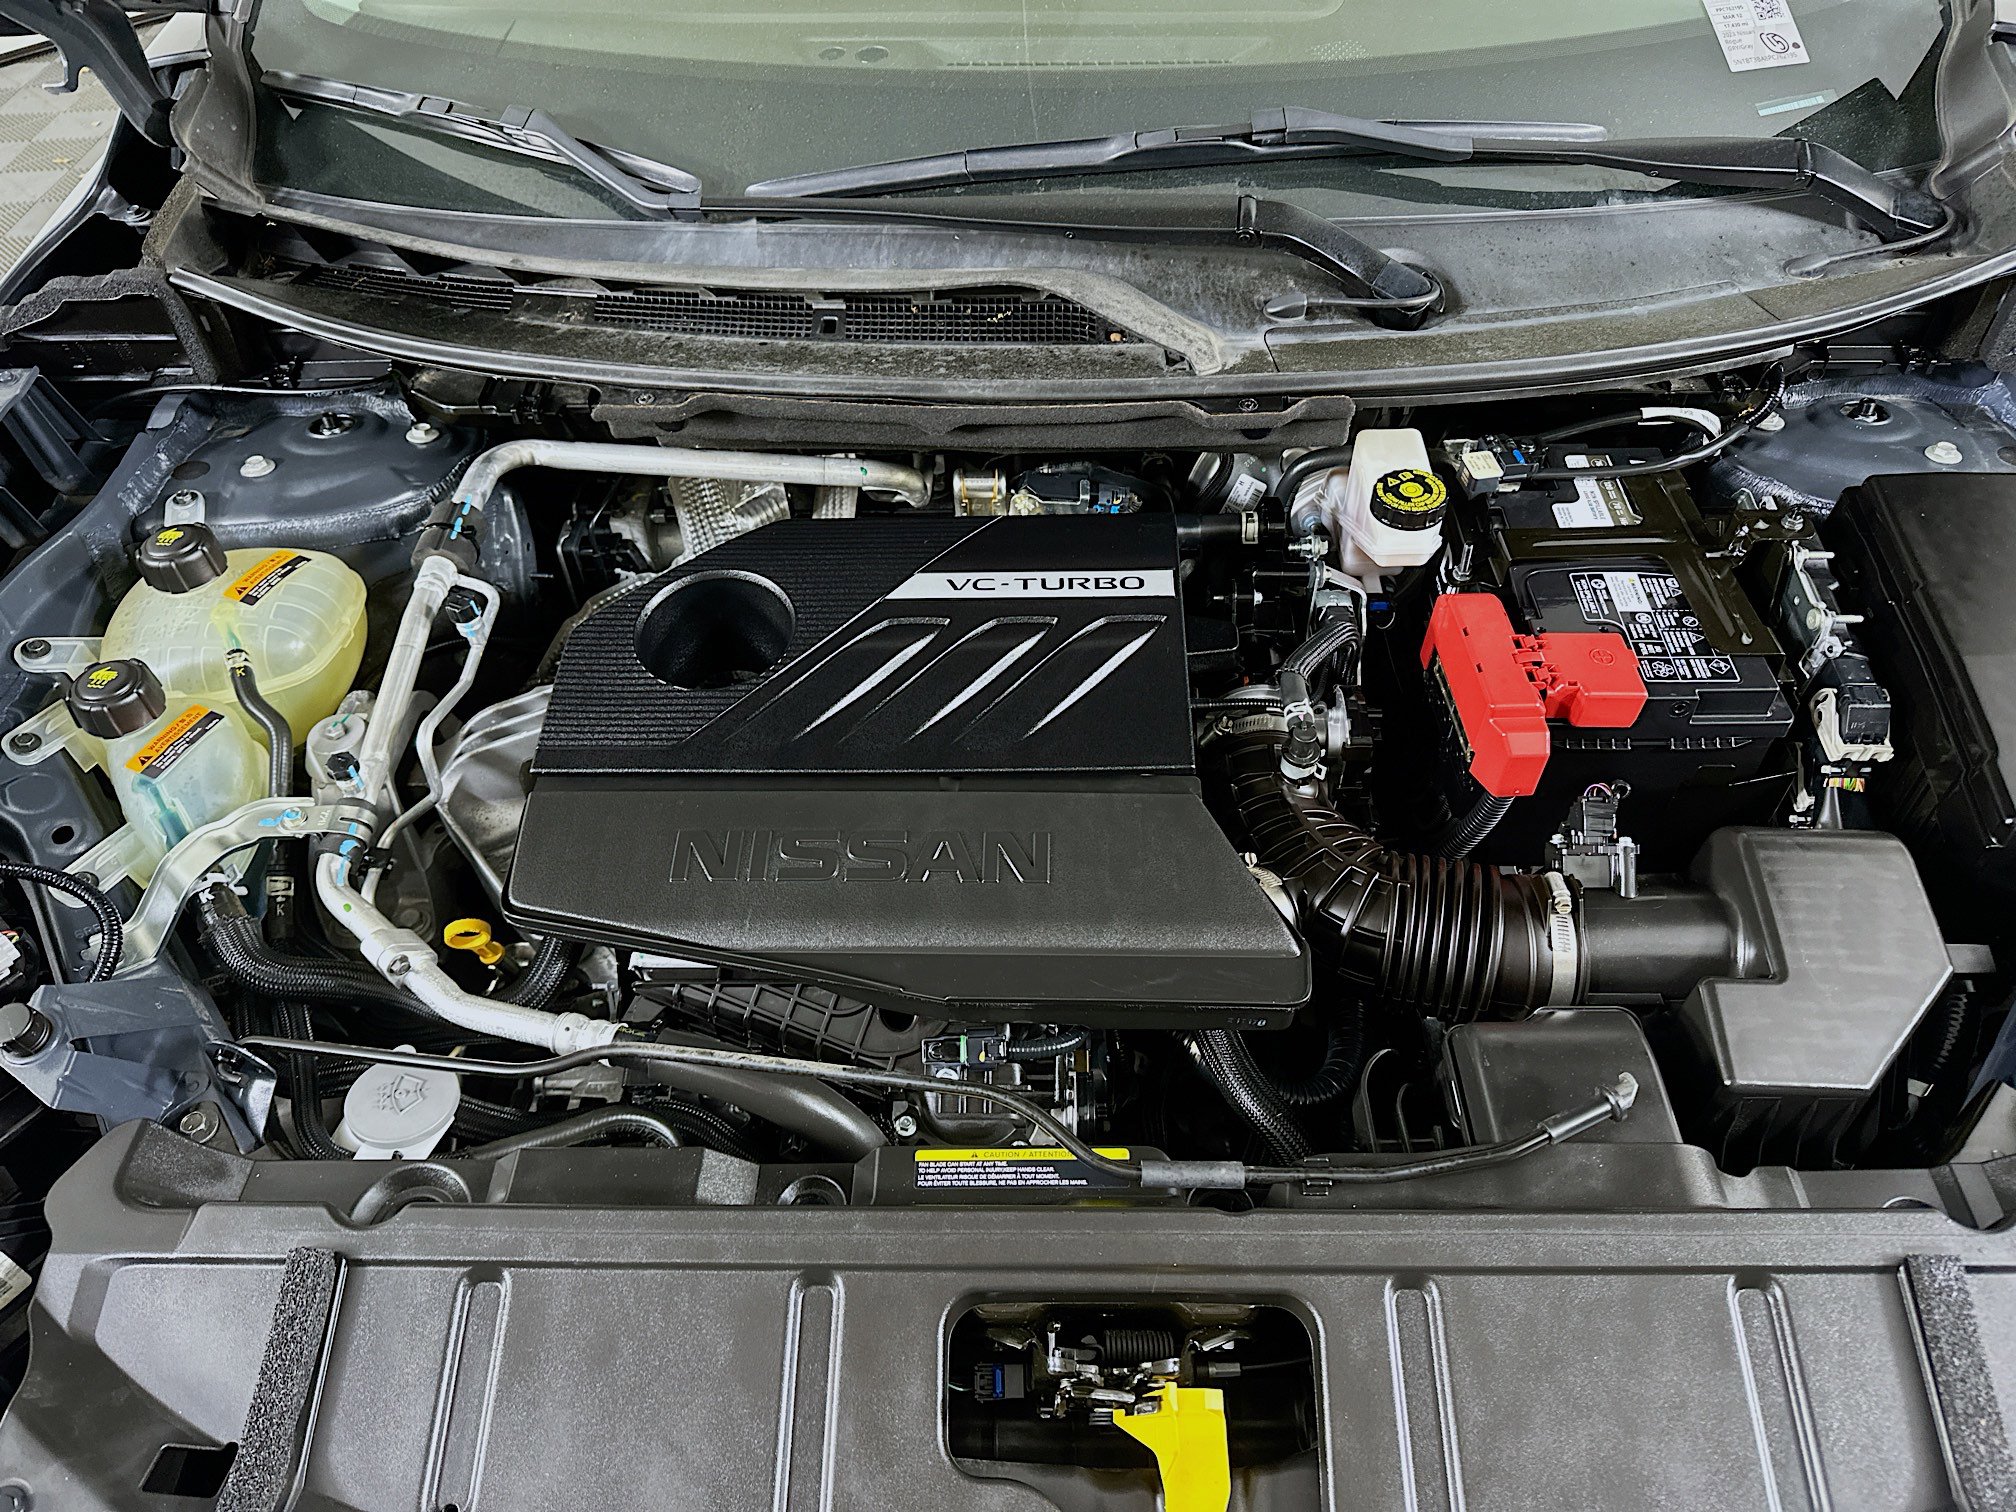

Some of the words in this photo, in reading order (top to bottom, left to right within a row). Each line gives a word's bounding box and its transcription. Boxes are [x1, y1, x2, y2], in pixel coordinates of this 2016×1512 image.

[946, 576, 1145, 590] VC-TURBO
[235, 667, 246, 677] K
[148, 727, 177, 750] WARNING
[155, 712, 202, 753] AVERTISSEMENT
[669, 830, 1051, 883] NISSAN
[199, 887, 215, 904] K
[277, 904, 285, 916] K
